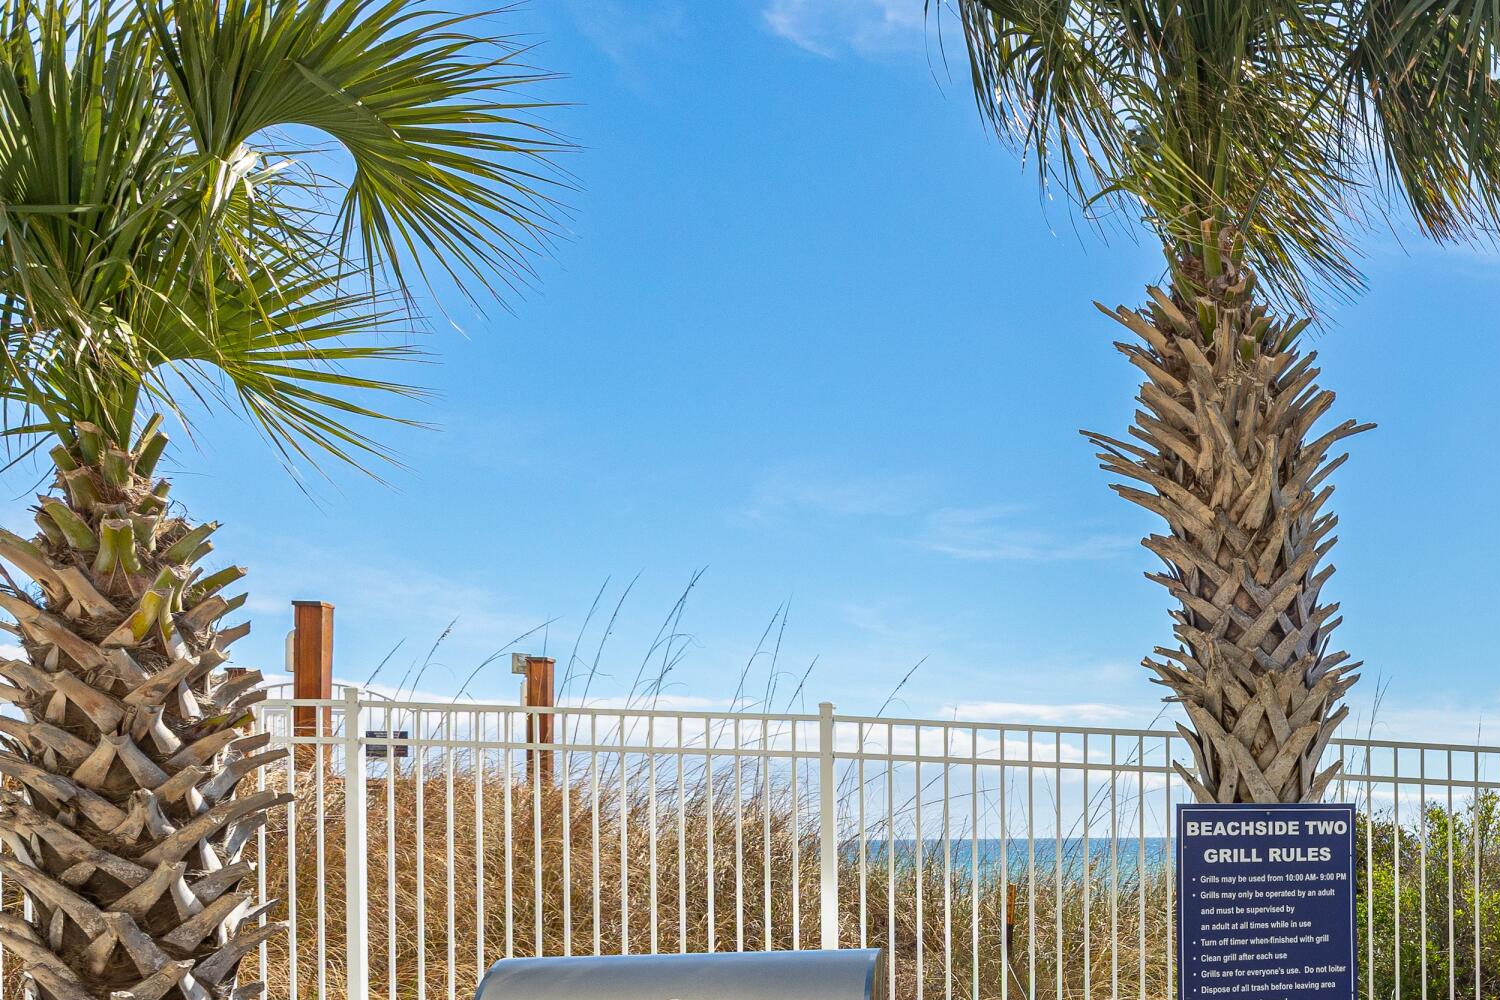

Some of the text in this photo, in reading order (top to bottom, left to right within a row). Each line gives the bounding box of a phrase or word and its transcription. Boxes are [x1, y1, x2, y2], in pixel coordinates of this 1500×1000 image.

[1187, 821, 1347, 836] BEACHSIDE TWO
[1204, 847, 1331, 863] GRILL RULES
[1320, 873, 1334, 881] 9:00
[1238, 890, 1253, 899] only
[1266, 890, 1296, 899] operated
[1246, 906, 1284, 914] supervised
[1286, 905, 1295, 914] by
[1212, 922, 1229, 930] adult
[1240, 921, 1248, 929] all
[1250, 921, 1269, 929] times
[1300, 935, 1314, 943] with
[1315, 935, 1329, 943] grill
[1223, 954, 1236, 963] grill
[1239, 953, 1254, 961] after
[1256, 952, 1273, 960] each
[1201, 970, 1220, 978] Grills
[1235, 968, 1245, 976] for
[1247, 967, 1284, 977] everyone's
[1201, 986, 1230, 995] Dispose
[1232, 984, 1240, 992] of
[1241, 984, 1250, 992] all
[1271, 983, 1293, 991] before
[1295, 981, 1319, 990] leaving
